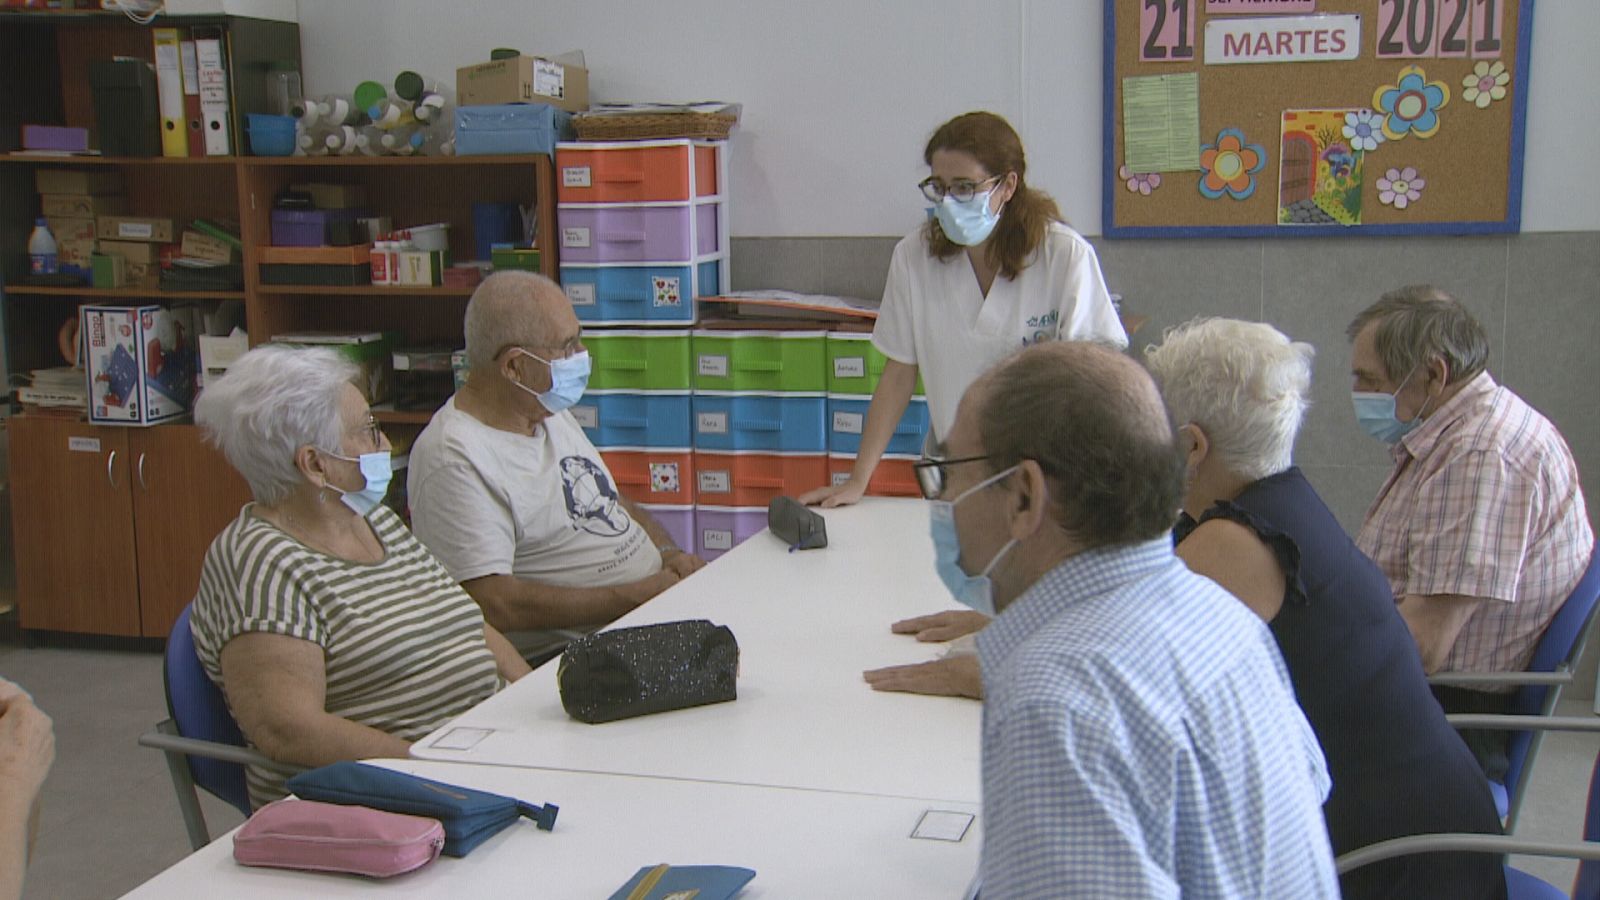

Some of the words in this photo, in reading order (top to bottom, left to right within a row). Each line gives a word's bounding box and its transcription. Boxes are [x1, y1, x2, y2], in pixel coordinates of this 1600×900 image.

[1143, 0, 1193, 58] 21
[1223, 29, 1346, 57] MARTES
[1378, 0, 1500, 55] 2021
